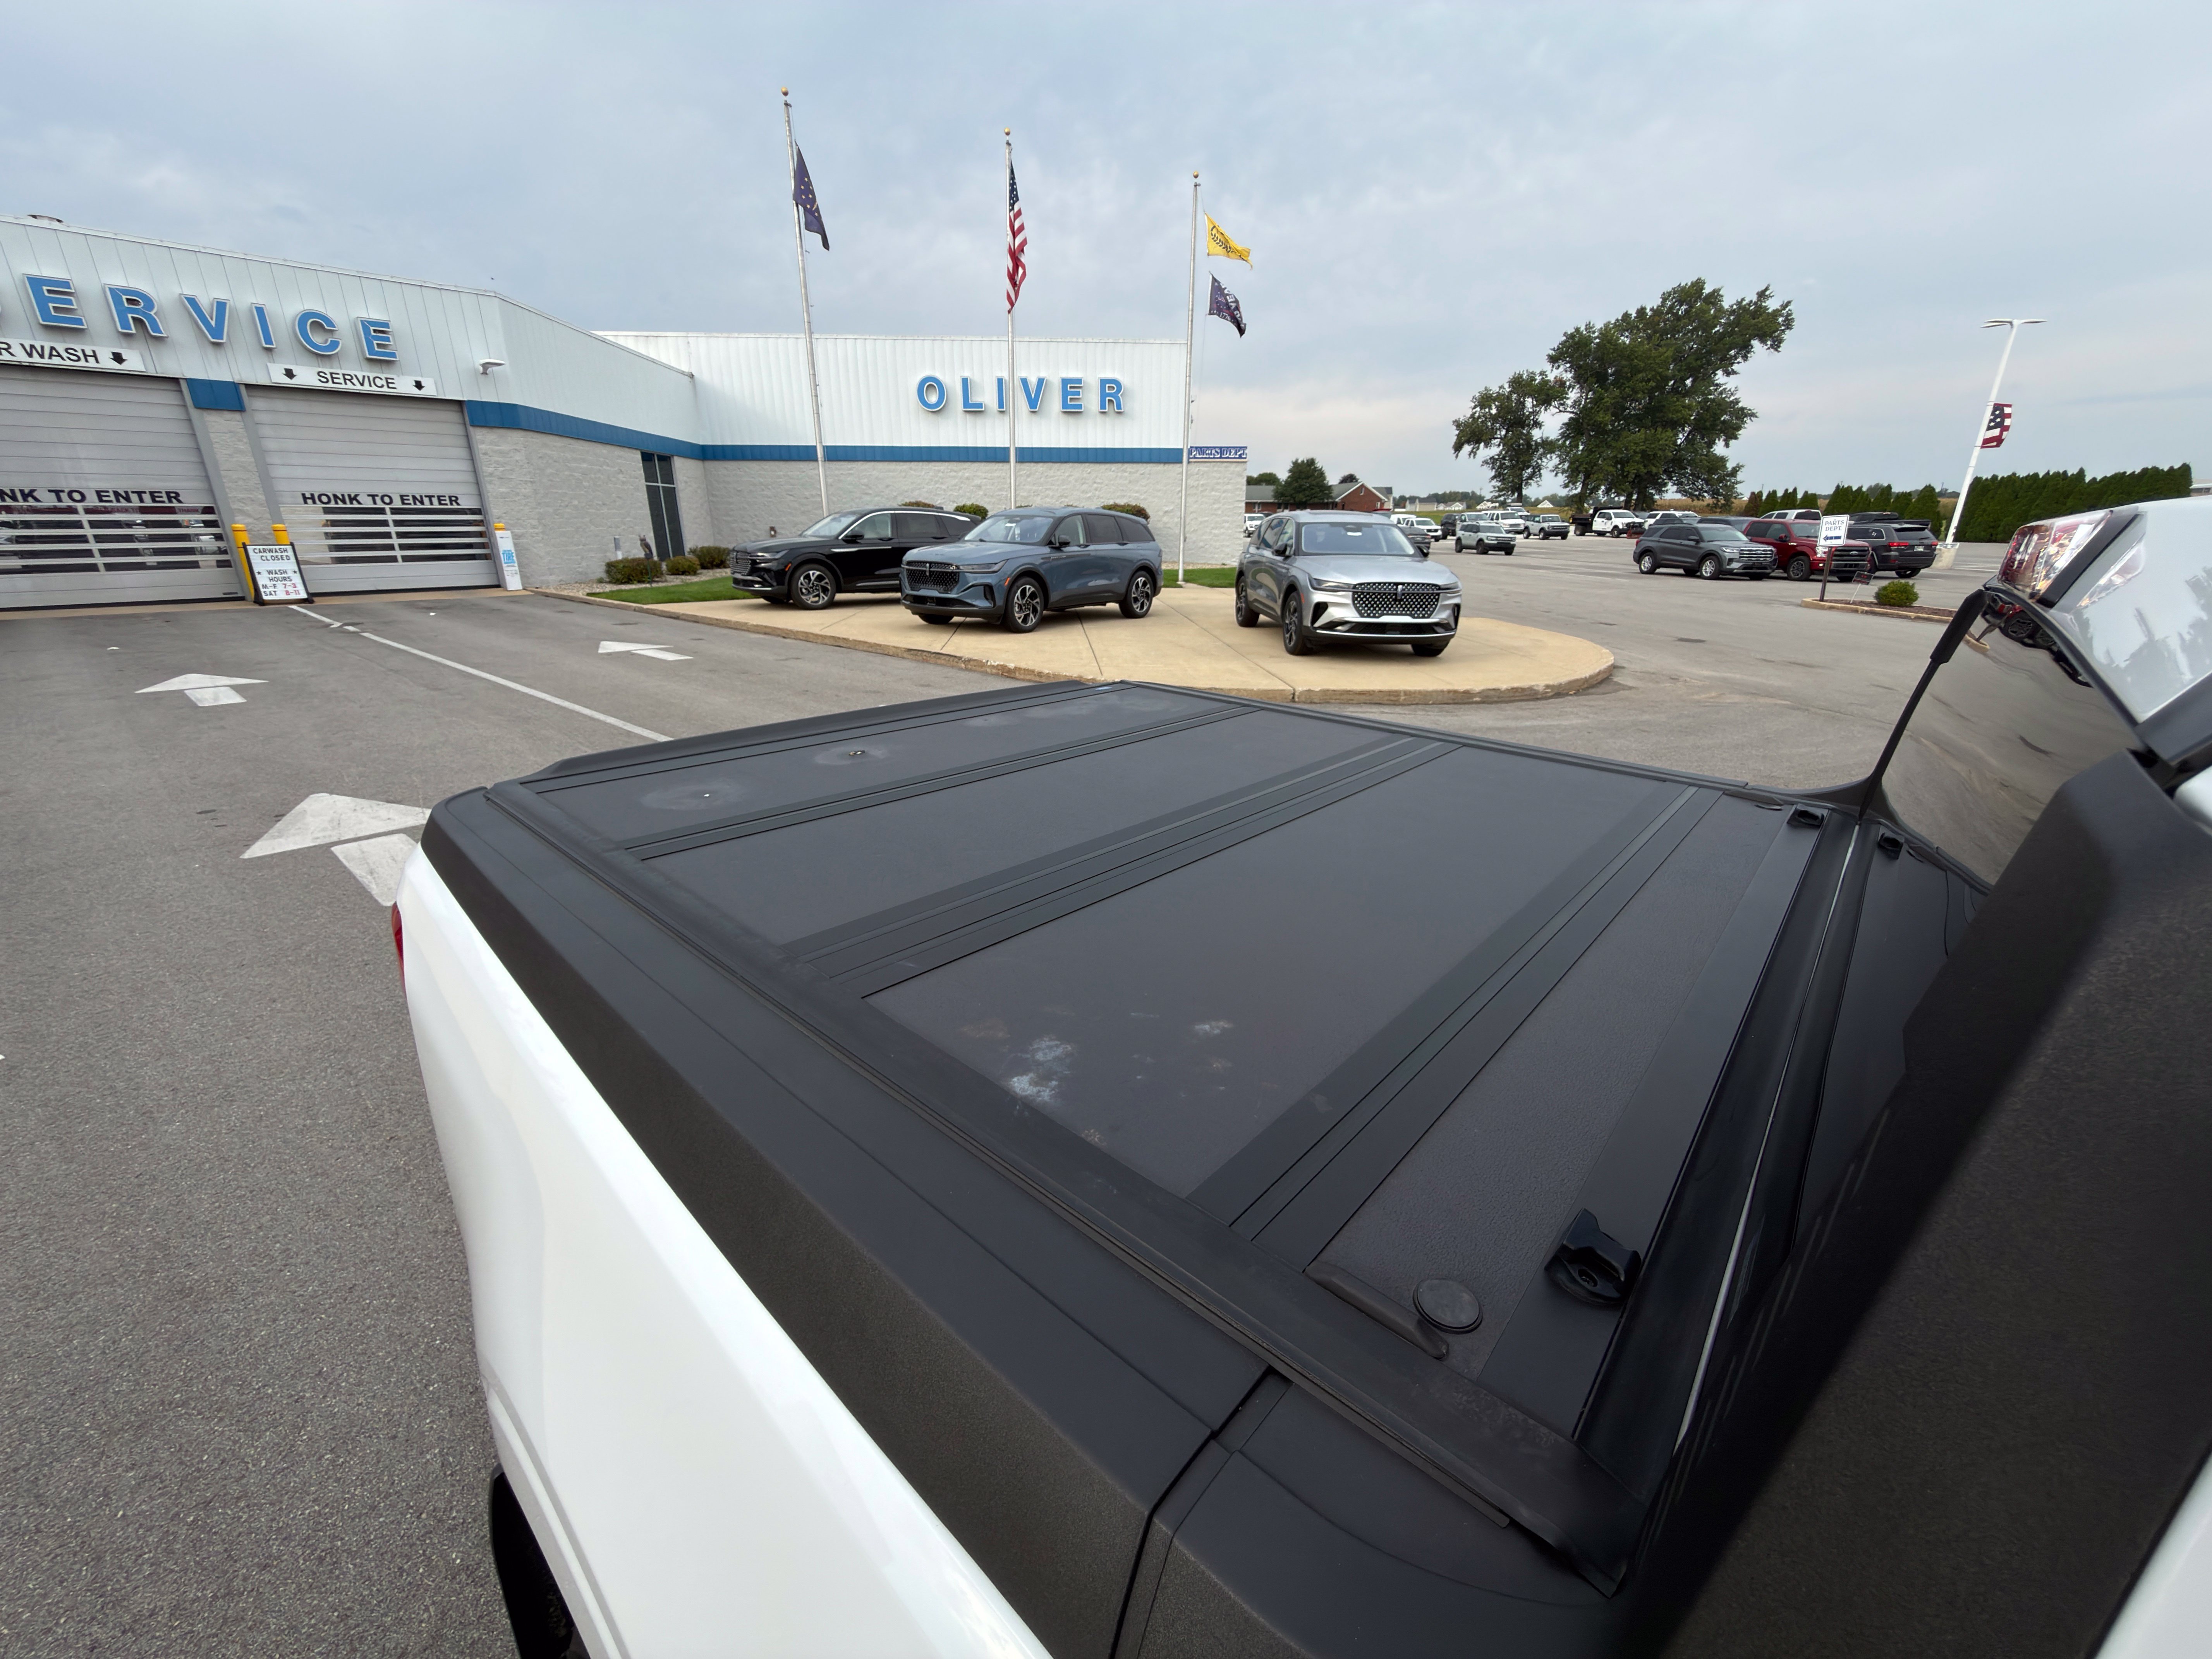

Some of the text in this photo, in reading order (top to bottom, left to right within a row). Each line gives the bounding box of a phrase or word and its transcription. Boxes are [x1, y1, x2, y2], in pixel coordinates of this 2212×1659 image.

[0, 273, 399, 361] ERVICE
[1220, 312, 1231, 321] 1776
[20, 343, 100, 364] WASH
[317, 371, 397, 390] SERVICE
[916, 374, 1125, 413] OLIVER
[1189, 448, 1246, 457] PARTS DEPT
[0, 488, 184, 503] NK TO ENTER
[301, 493, 461, 506] HONK TO ENTER
